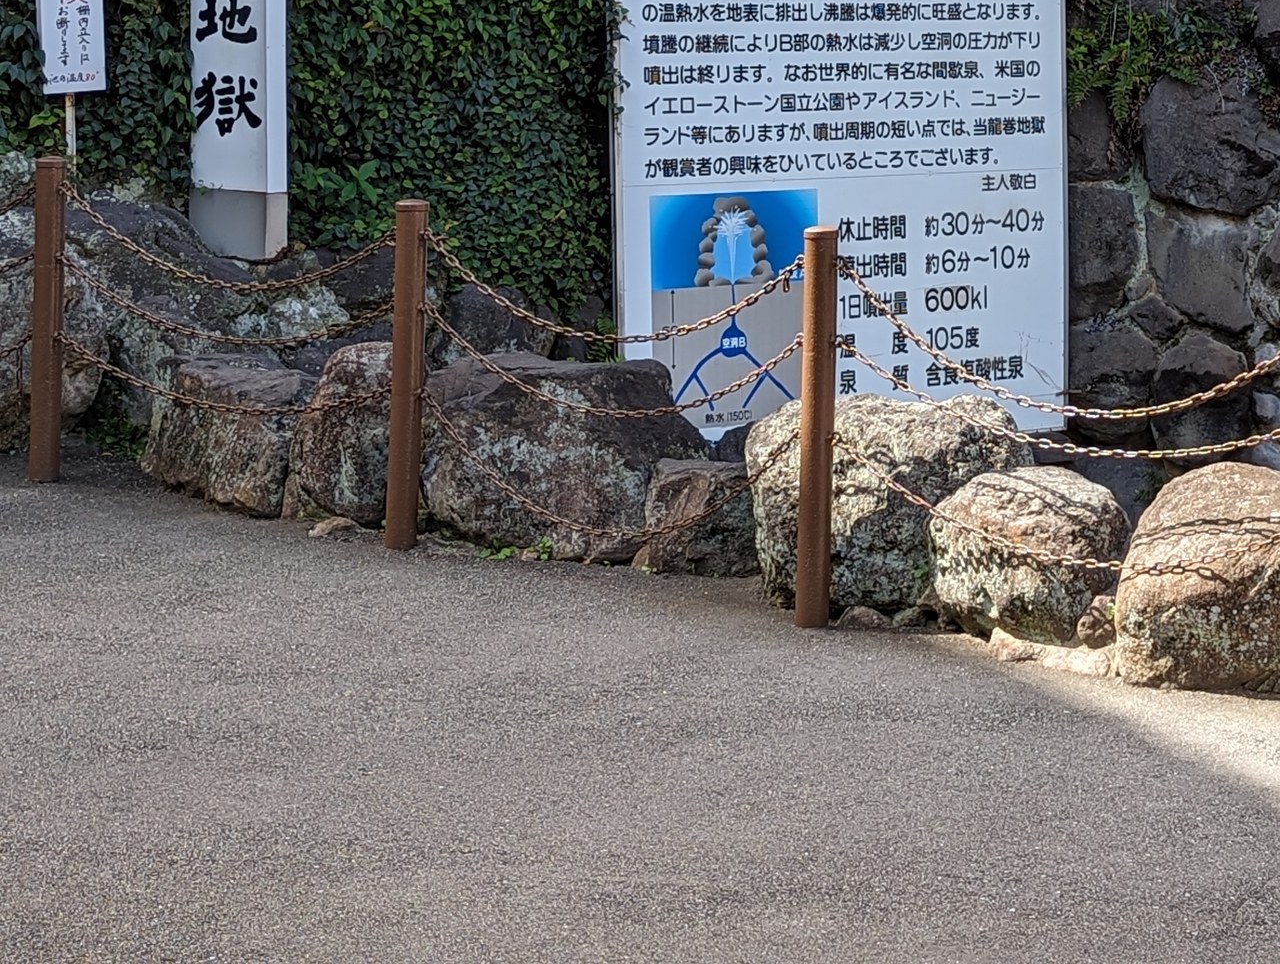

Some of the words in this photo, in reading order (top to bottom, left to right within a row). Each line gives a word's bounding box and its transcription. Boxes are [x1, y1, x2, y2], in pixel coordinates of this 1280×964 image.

[981, 173, 1037, 192] 主人敬白
[838, 215, 907, 243] 休止時間
[926, 326, 981, 352] 105度
